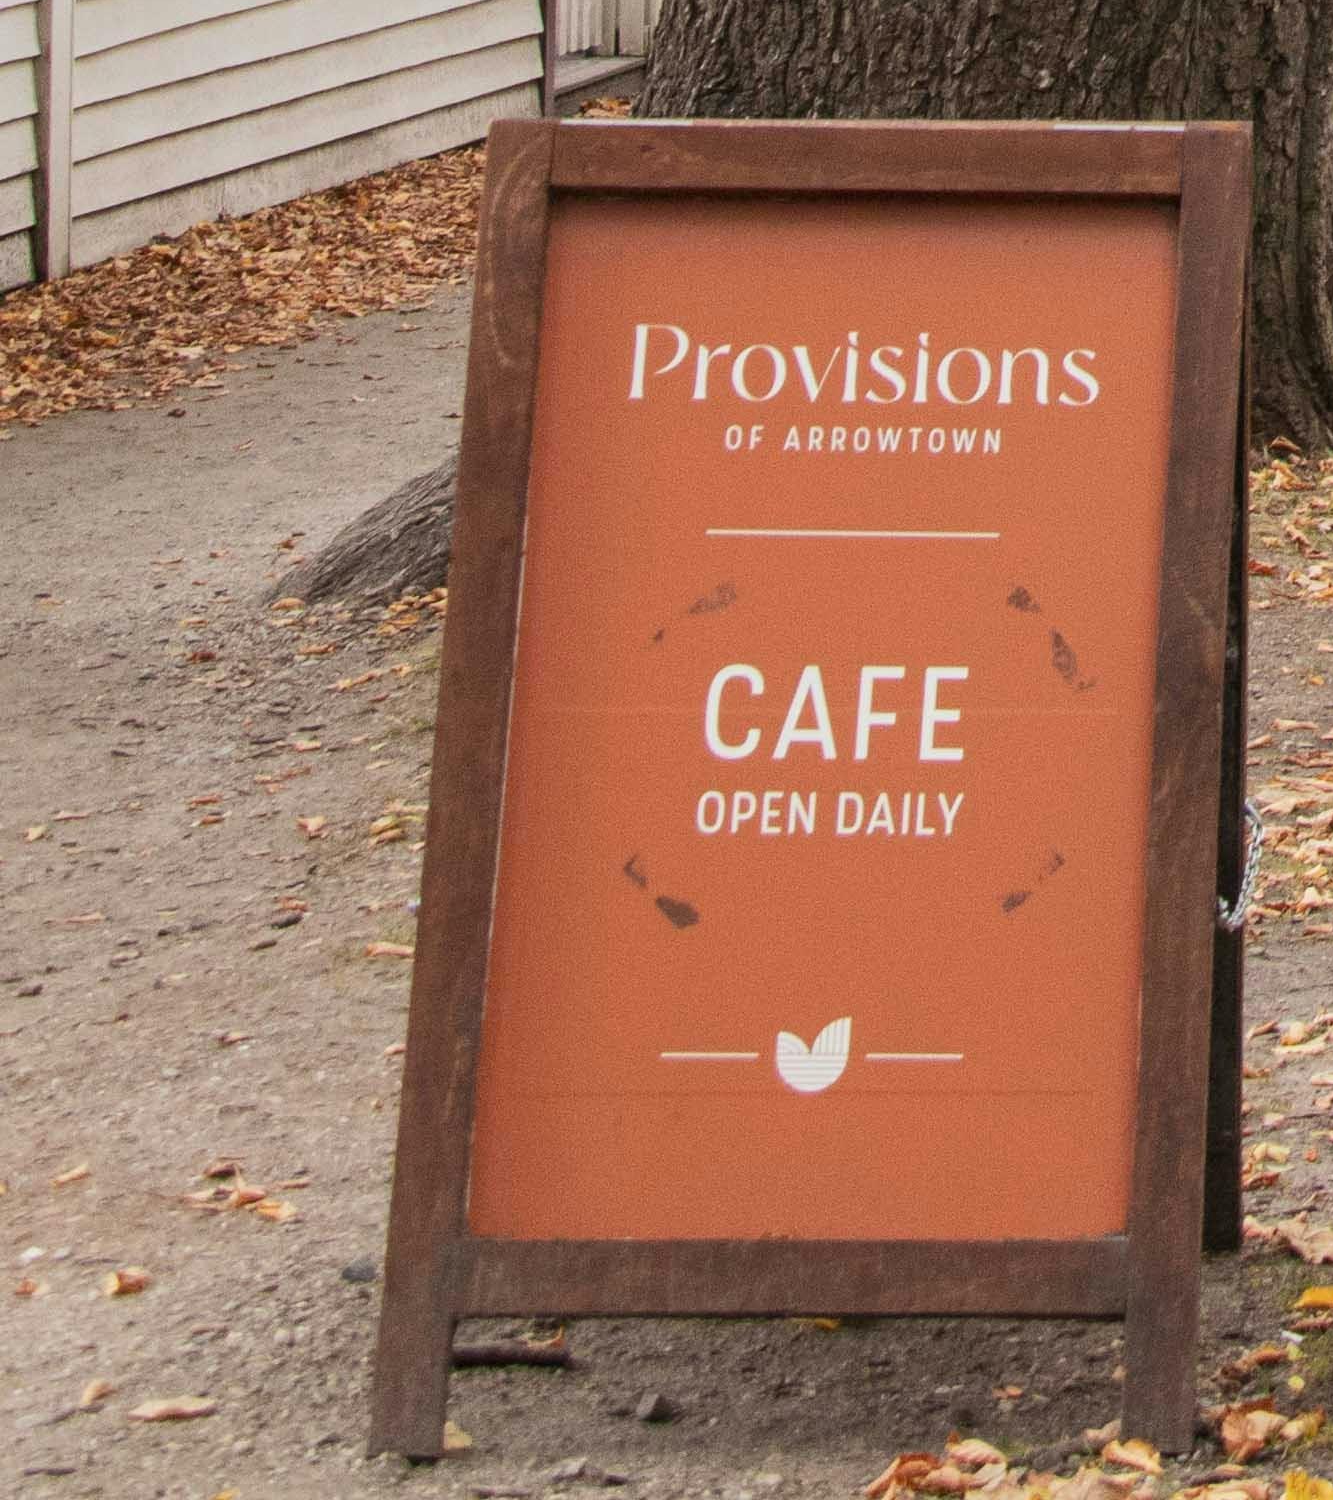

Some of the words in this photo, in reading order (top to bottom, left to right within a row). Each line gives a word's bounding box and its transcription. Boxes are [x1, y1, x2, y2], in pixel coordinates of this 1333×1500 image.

[628, 323, 1101, 407] Provisions
[724, 425, 764, 451] OF
[782, 426, 1002, 455] ARROWTOWN
[703, 663, 970, 763] CAFE
[695, 789, 818, 836] OPEN
[835, 791, 965, 838] DAILY
